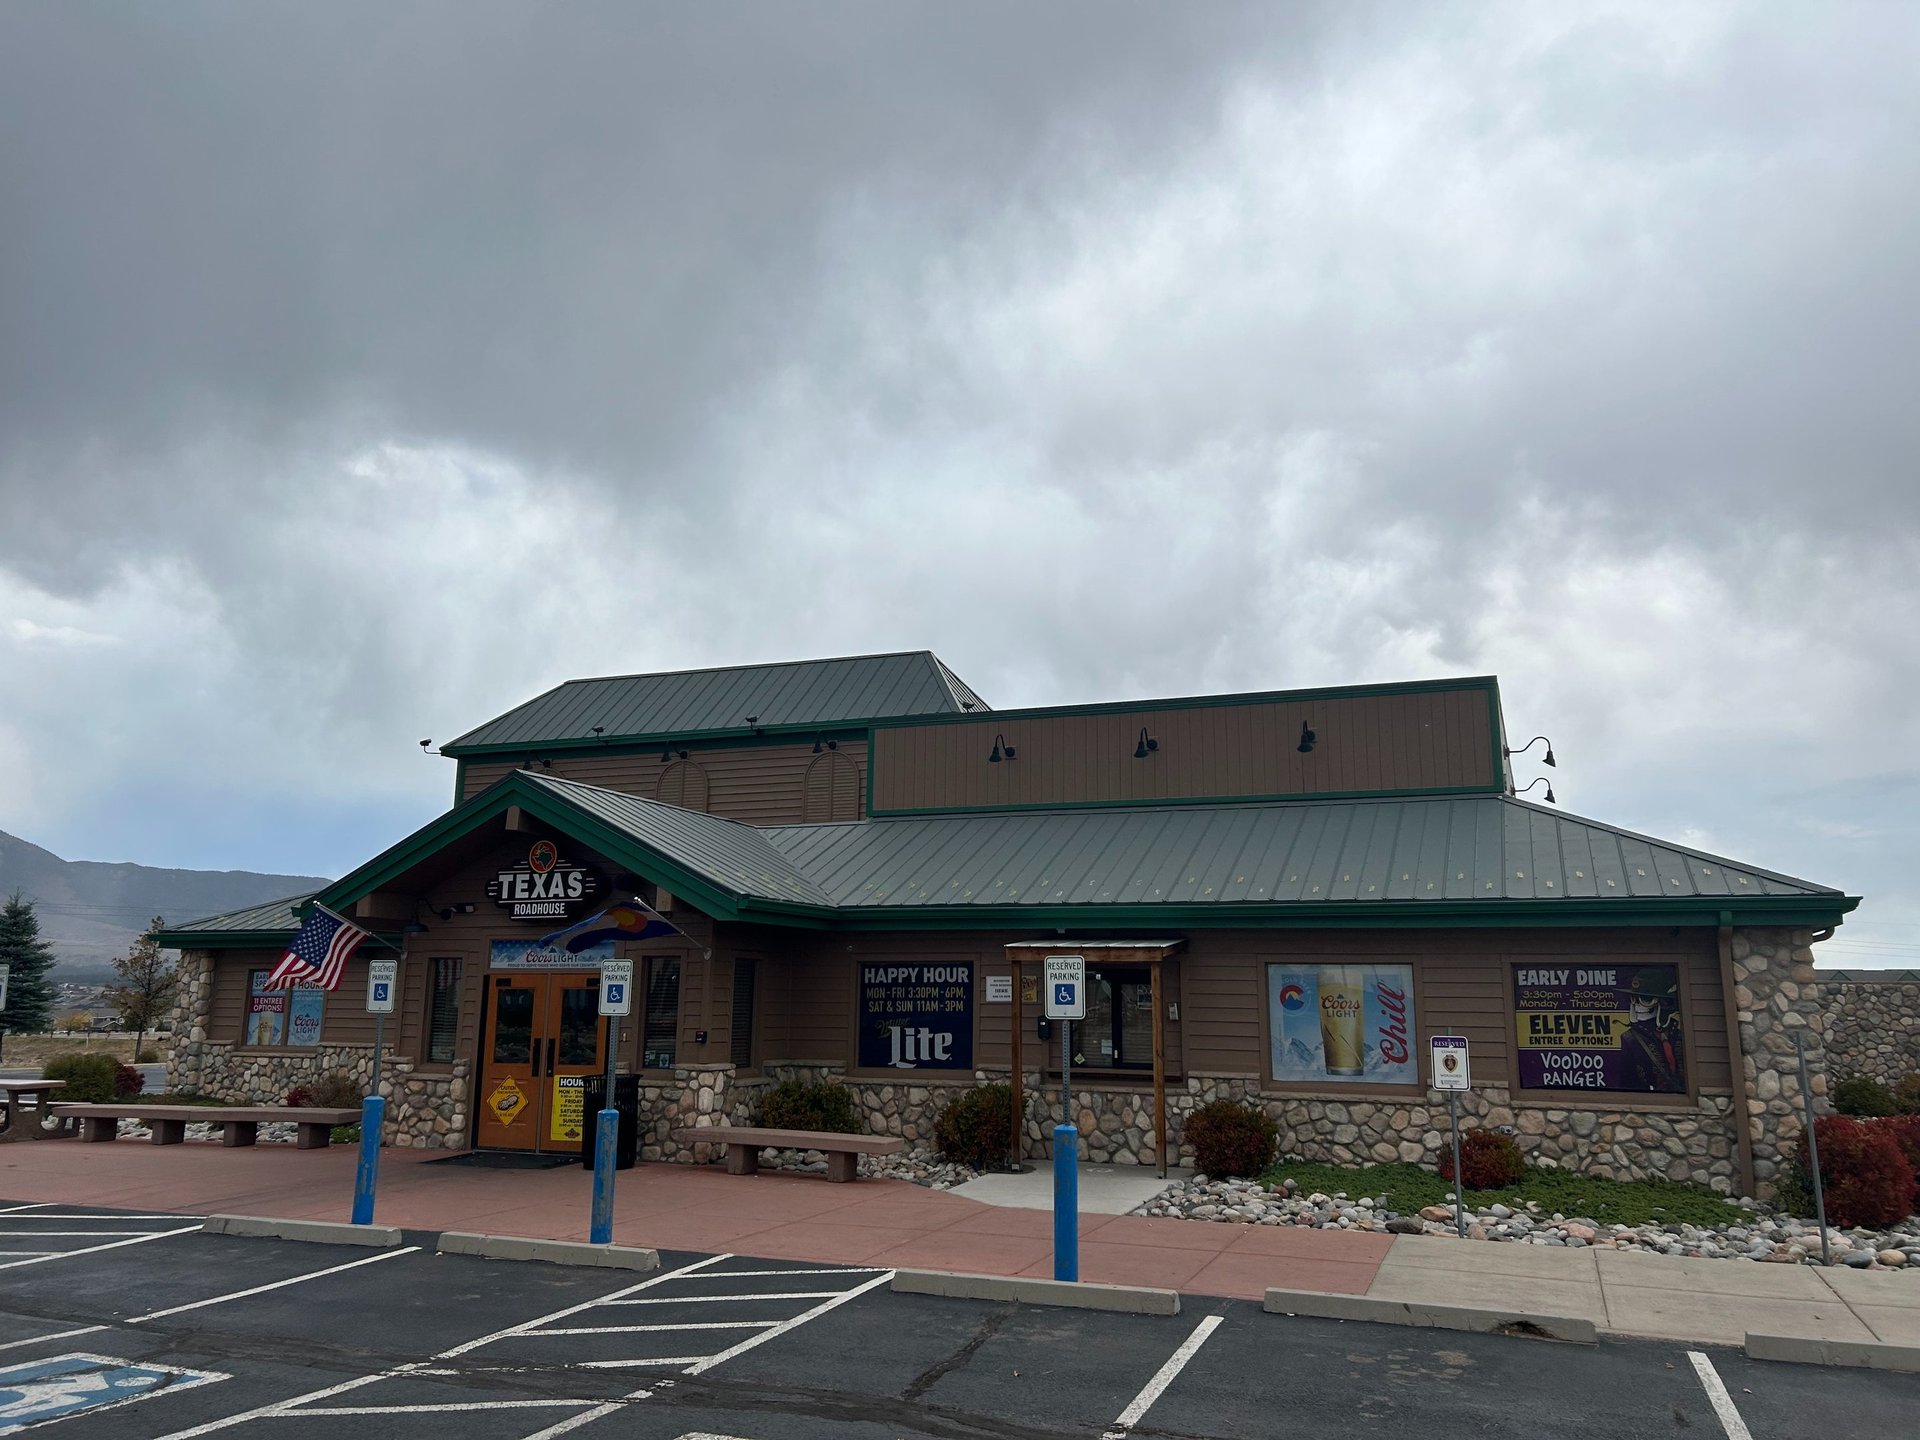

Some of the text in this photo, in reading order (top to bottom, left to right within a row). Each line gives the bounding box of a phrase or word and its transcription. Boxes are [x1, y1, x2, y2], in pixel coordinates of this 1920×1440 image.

[498, 871, 582, 899] TEXAS
[514, 903, 565, 915] ROADHOUSE
[526, 950, 578, 962] Coors LIGHT
[1048, 962, 1081, 970] RESERVED
[865, 967, 968, 983] HAPPY HOUR
[1050, 972, 1080, 980] PARKING
[1517, 970, 1616, 986] EARLY DINE
[298, 981, 324, 989] HOUR
[1523, 991, 1562, 999] 3:30pm
[1573, 991, 1614, 999] 5:00pm
[869, 1001, 884, 1012] SAT
[886, 1001, 893, 1012] &
[896, 1001, 913, 1012] SUN
[1321, 995, 1360, 1010] Coors
[1519, 1000, 1558, 1009] Monday
[1570, 1000, 1618, 1009] Thursday
[1326, 1010, 1357, 1018] LIGHT
[294, 1015, 319, 1027] Coors
[1377, 979, 1408, 1064] Chill
[1529, 1015, 1611, 1035] ELEVEN
[1529, 1036, 1613, 1045] ENTREE OPTIONS!
[888, 1026, 952, 1068] Lite
[560, 1078, 584, 1086] HOUR
[1543, 1071, 1606, 1087] RANGER
